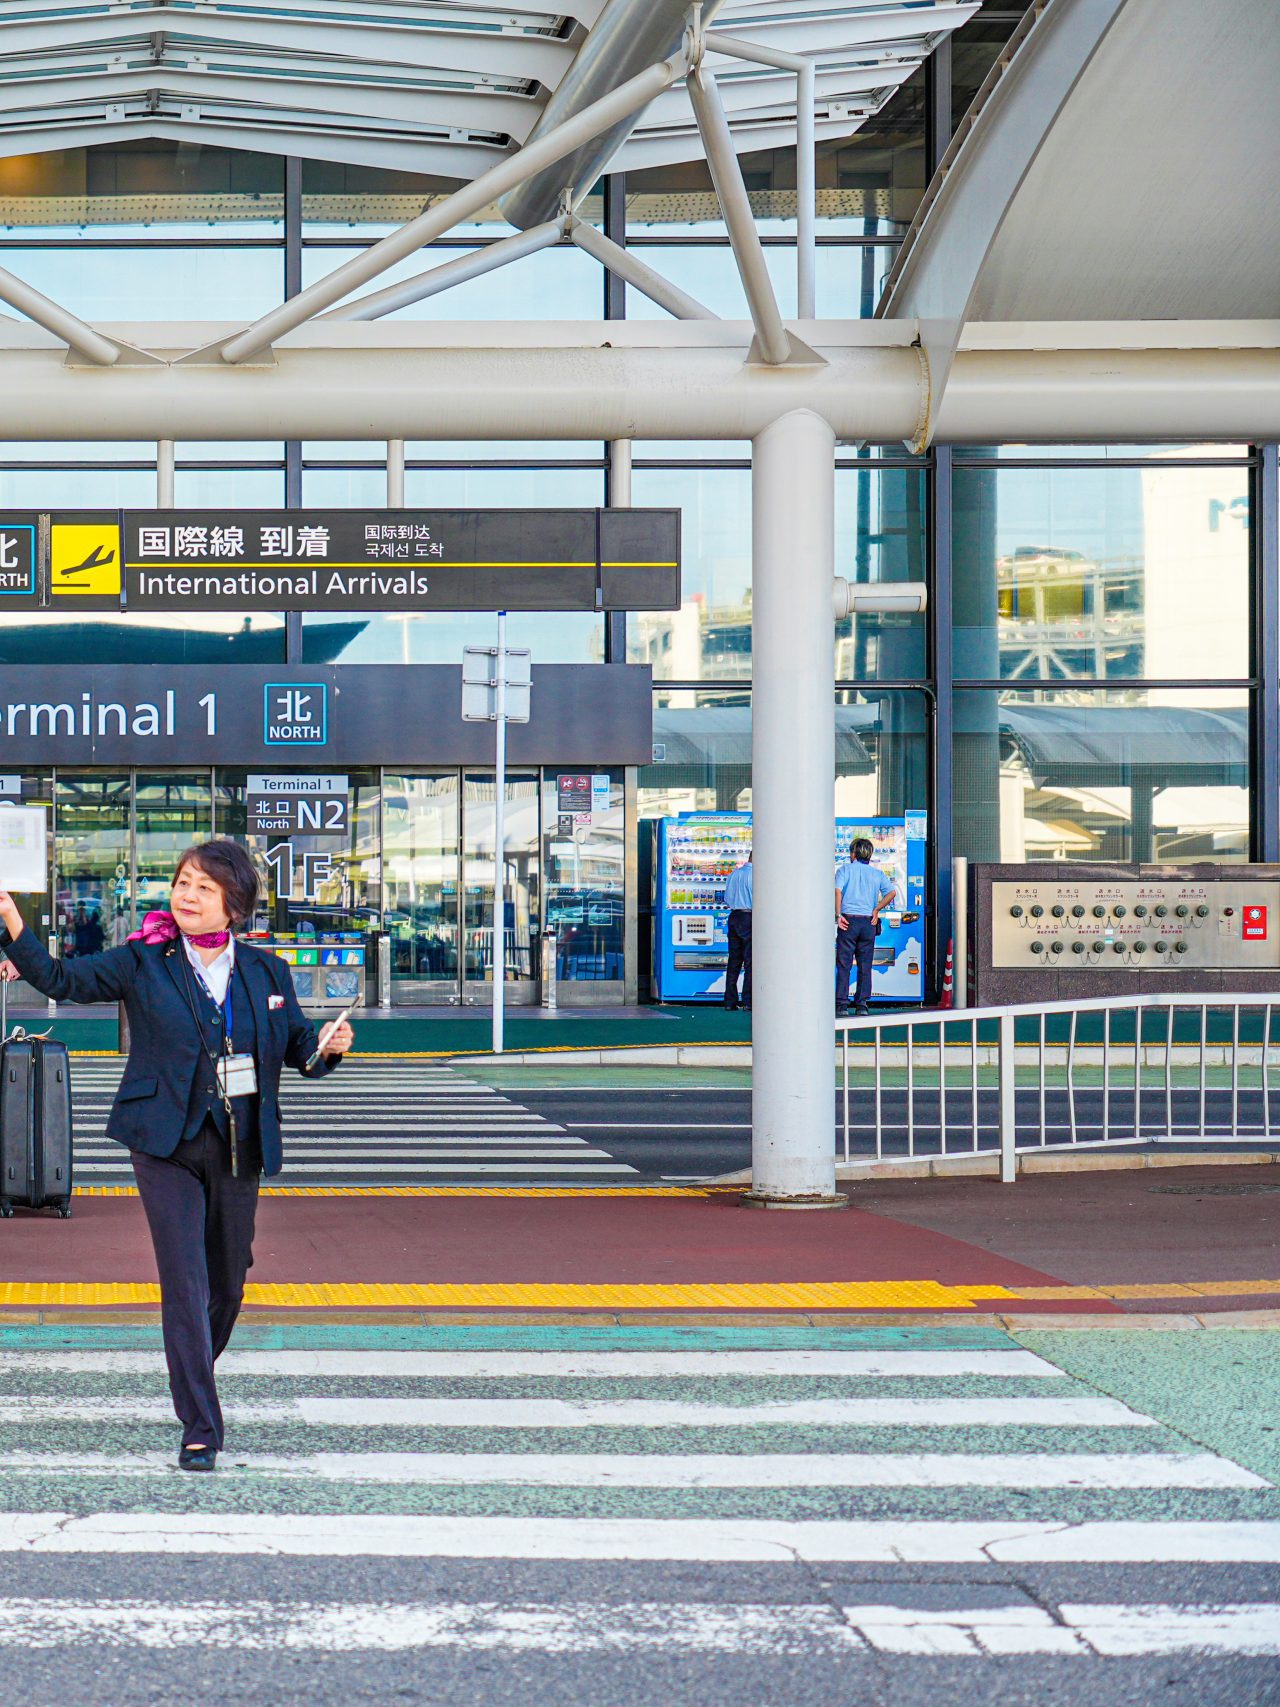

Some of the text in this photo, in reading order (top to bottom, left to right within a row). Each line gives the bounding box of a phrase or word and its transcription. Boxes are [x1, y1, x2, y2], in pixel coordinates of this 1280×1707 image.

[138, 525, 331, 557] 国際線 到着
[364, 524, 431, 540] 国际到达
[365, 542, 445, 558] 국제선 도착
[139, 570, 429, 595] International Arrivals
[198, 693, 216, 736] 1
[276, 690, 312, 723] 北
[269, 725, 321, 739] NORTH
[262, 778, 332, 790] Terminal 1
[256, 800, 290, 814] 北口
[297, 800, 345, 829] N2
[257, 818, 290, 829] North
[264, 842, 331, 898] 1F
